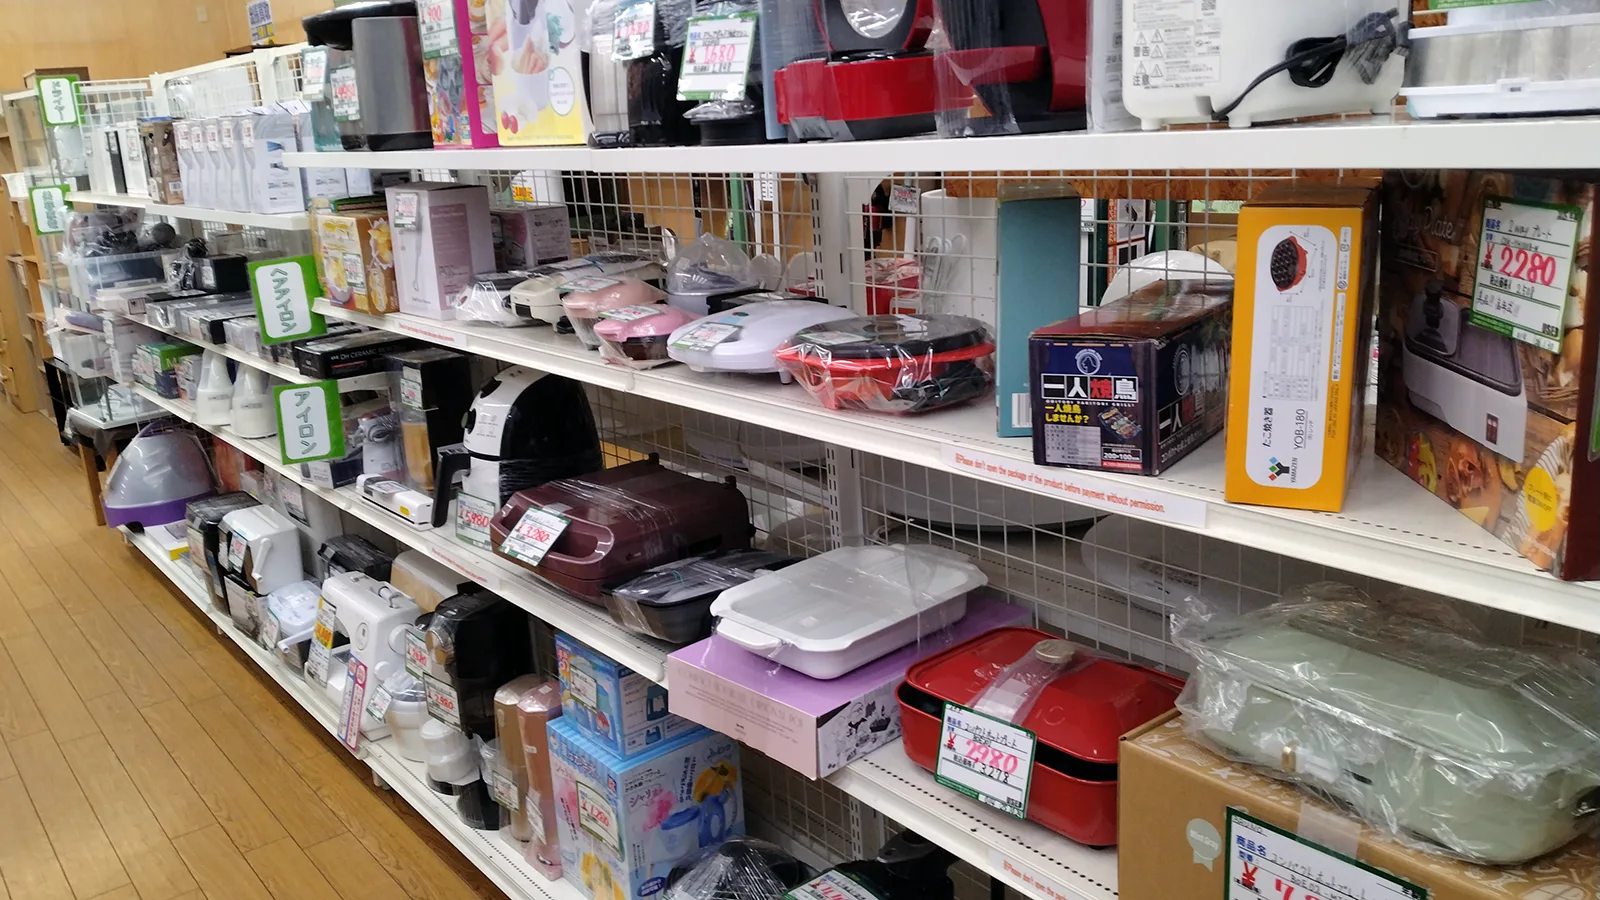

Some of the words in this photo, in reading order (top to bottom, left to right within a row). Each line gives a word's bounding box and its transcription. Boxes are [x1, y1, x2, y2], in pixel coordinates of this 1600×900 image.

[1133, 74, 1150, 86] 注意
[270, 267, 297, 333] ヘアアイロン
[1542, 323, 1559, 337] USED
[1043, 377, 1137, 401] 一人焼鳥
[1044, 404, 1082, 414] 一人焼鳥
[294, 391, 316, 455] アイロン
[1262, 407, 1274, 448] たこ焼き器
[1294, 408, 1306, 450] YOB-180
[987, 464, 998, 474] open
[1007, 468, 1027, 482] package
[1028, 472, 1034, 481] of
[1034, 474, 1043, 484] the
[1043, 478, 1063, 491] product
[1064, 482, 1081, 494] before
[1082, 487, 1105, 501] payment
[1106, 491, 1128, 505] without
[1235, 834, 1267, 857] 商品名
[1242, 861, 1259, 887] ¥
